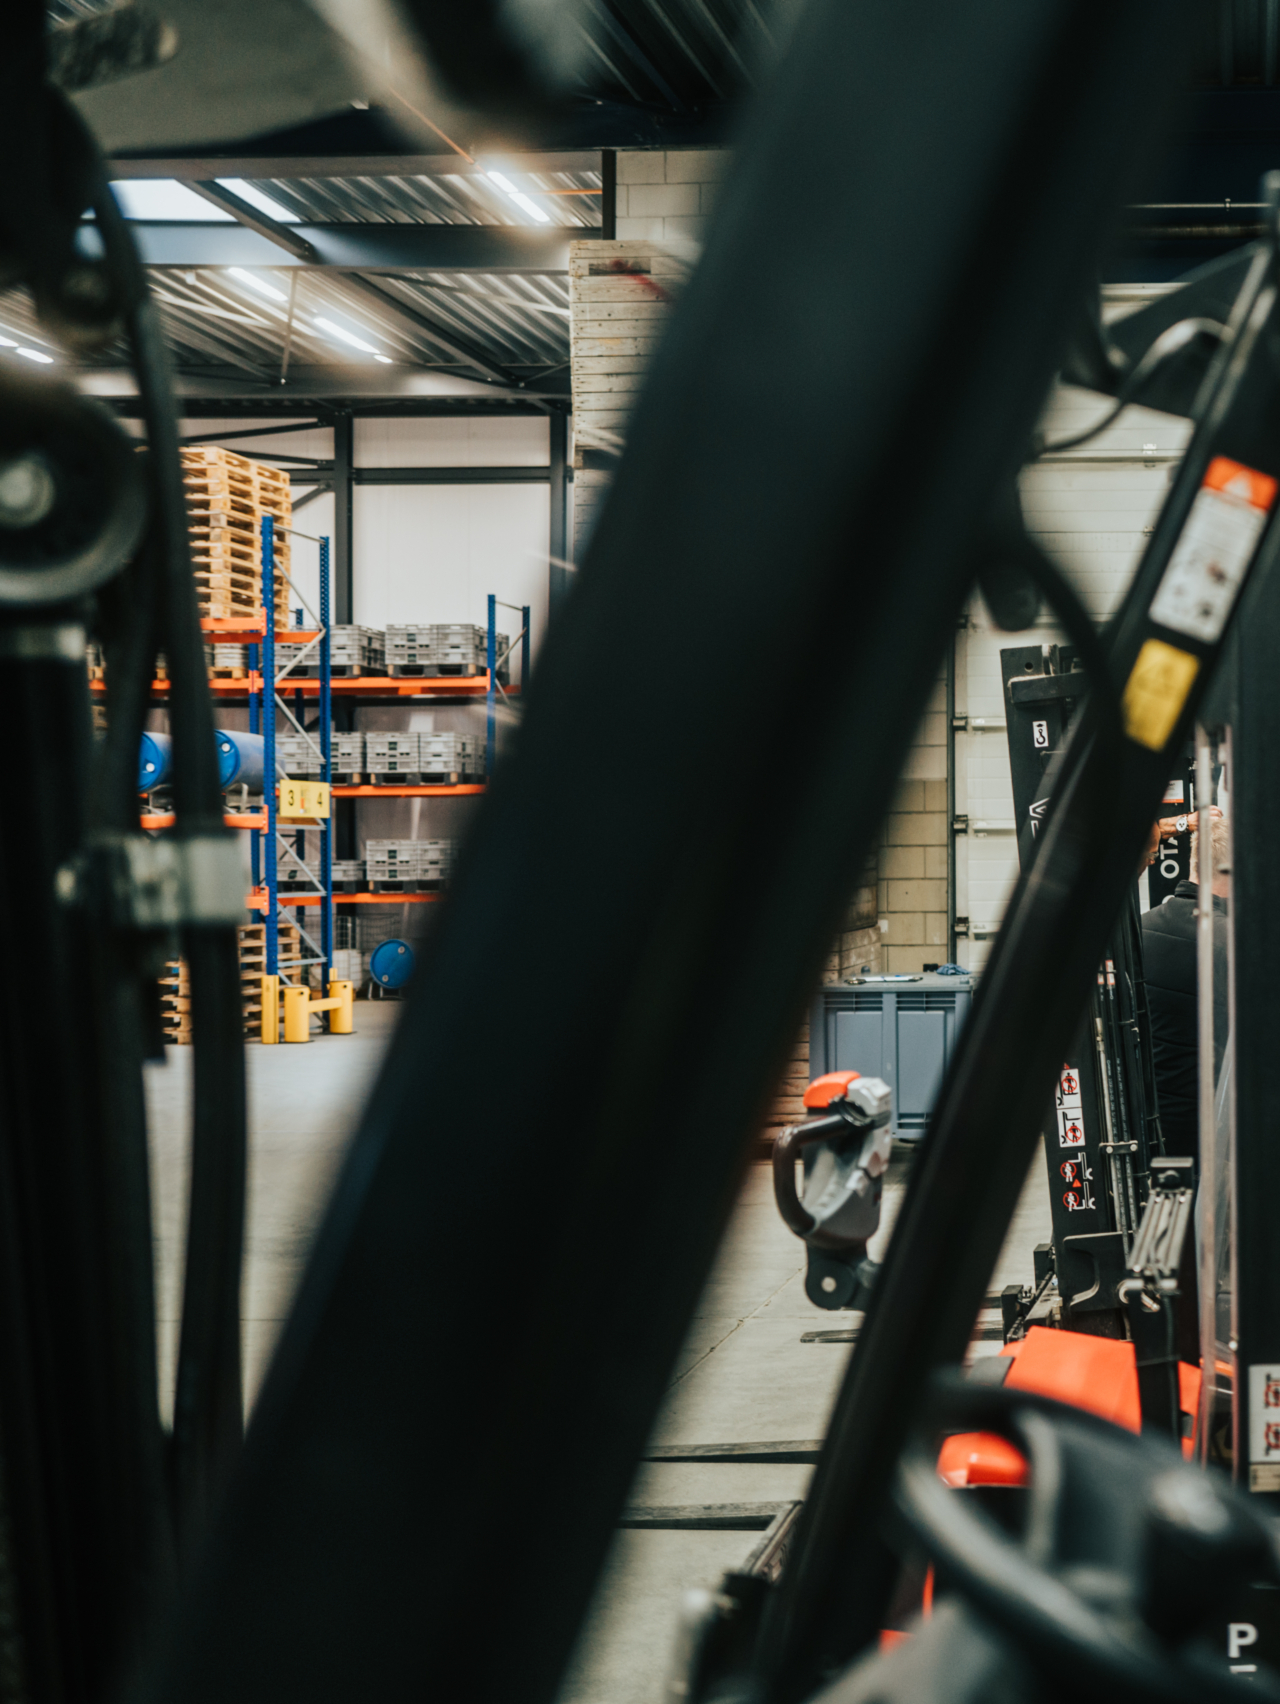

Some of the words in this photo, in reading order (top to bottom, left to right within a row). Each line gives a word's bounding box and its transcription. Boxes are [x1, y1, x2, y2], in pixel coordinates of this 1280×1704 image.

[288, 789, 295, 806] 3
[316, 792, 323, 808] 4
[1227, 1622, 1258, 1658] P
